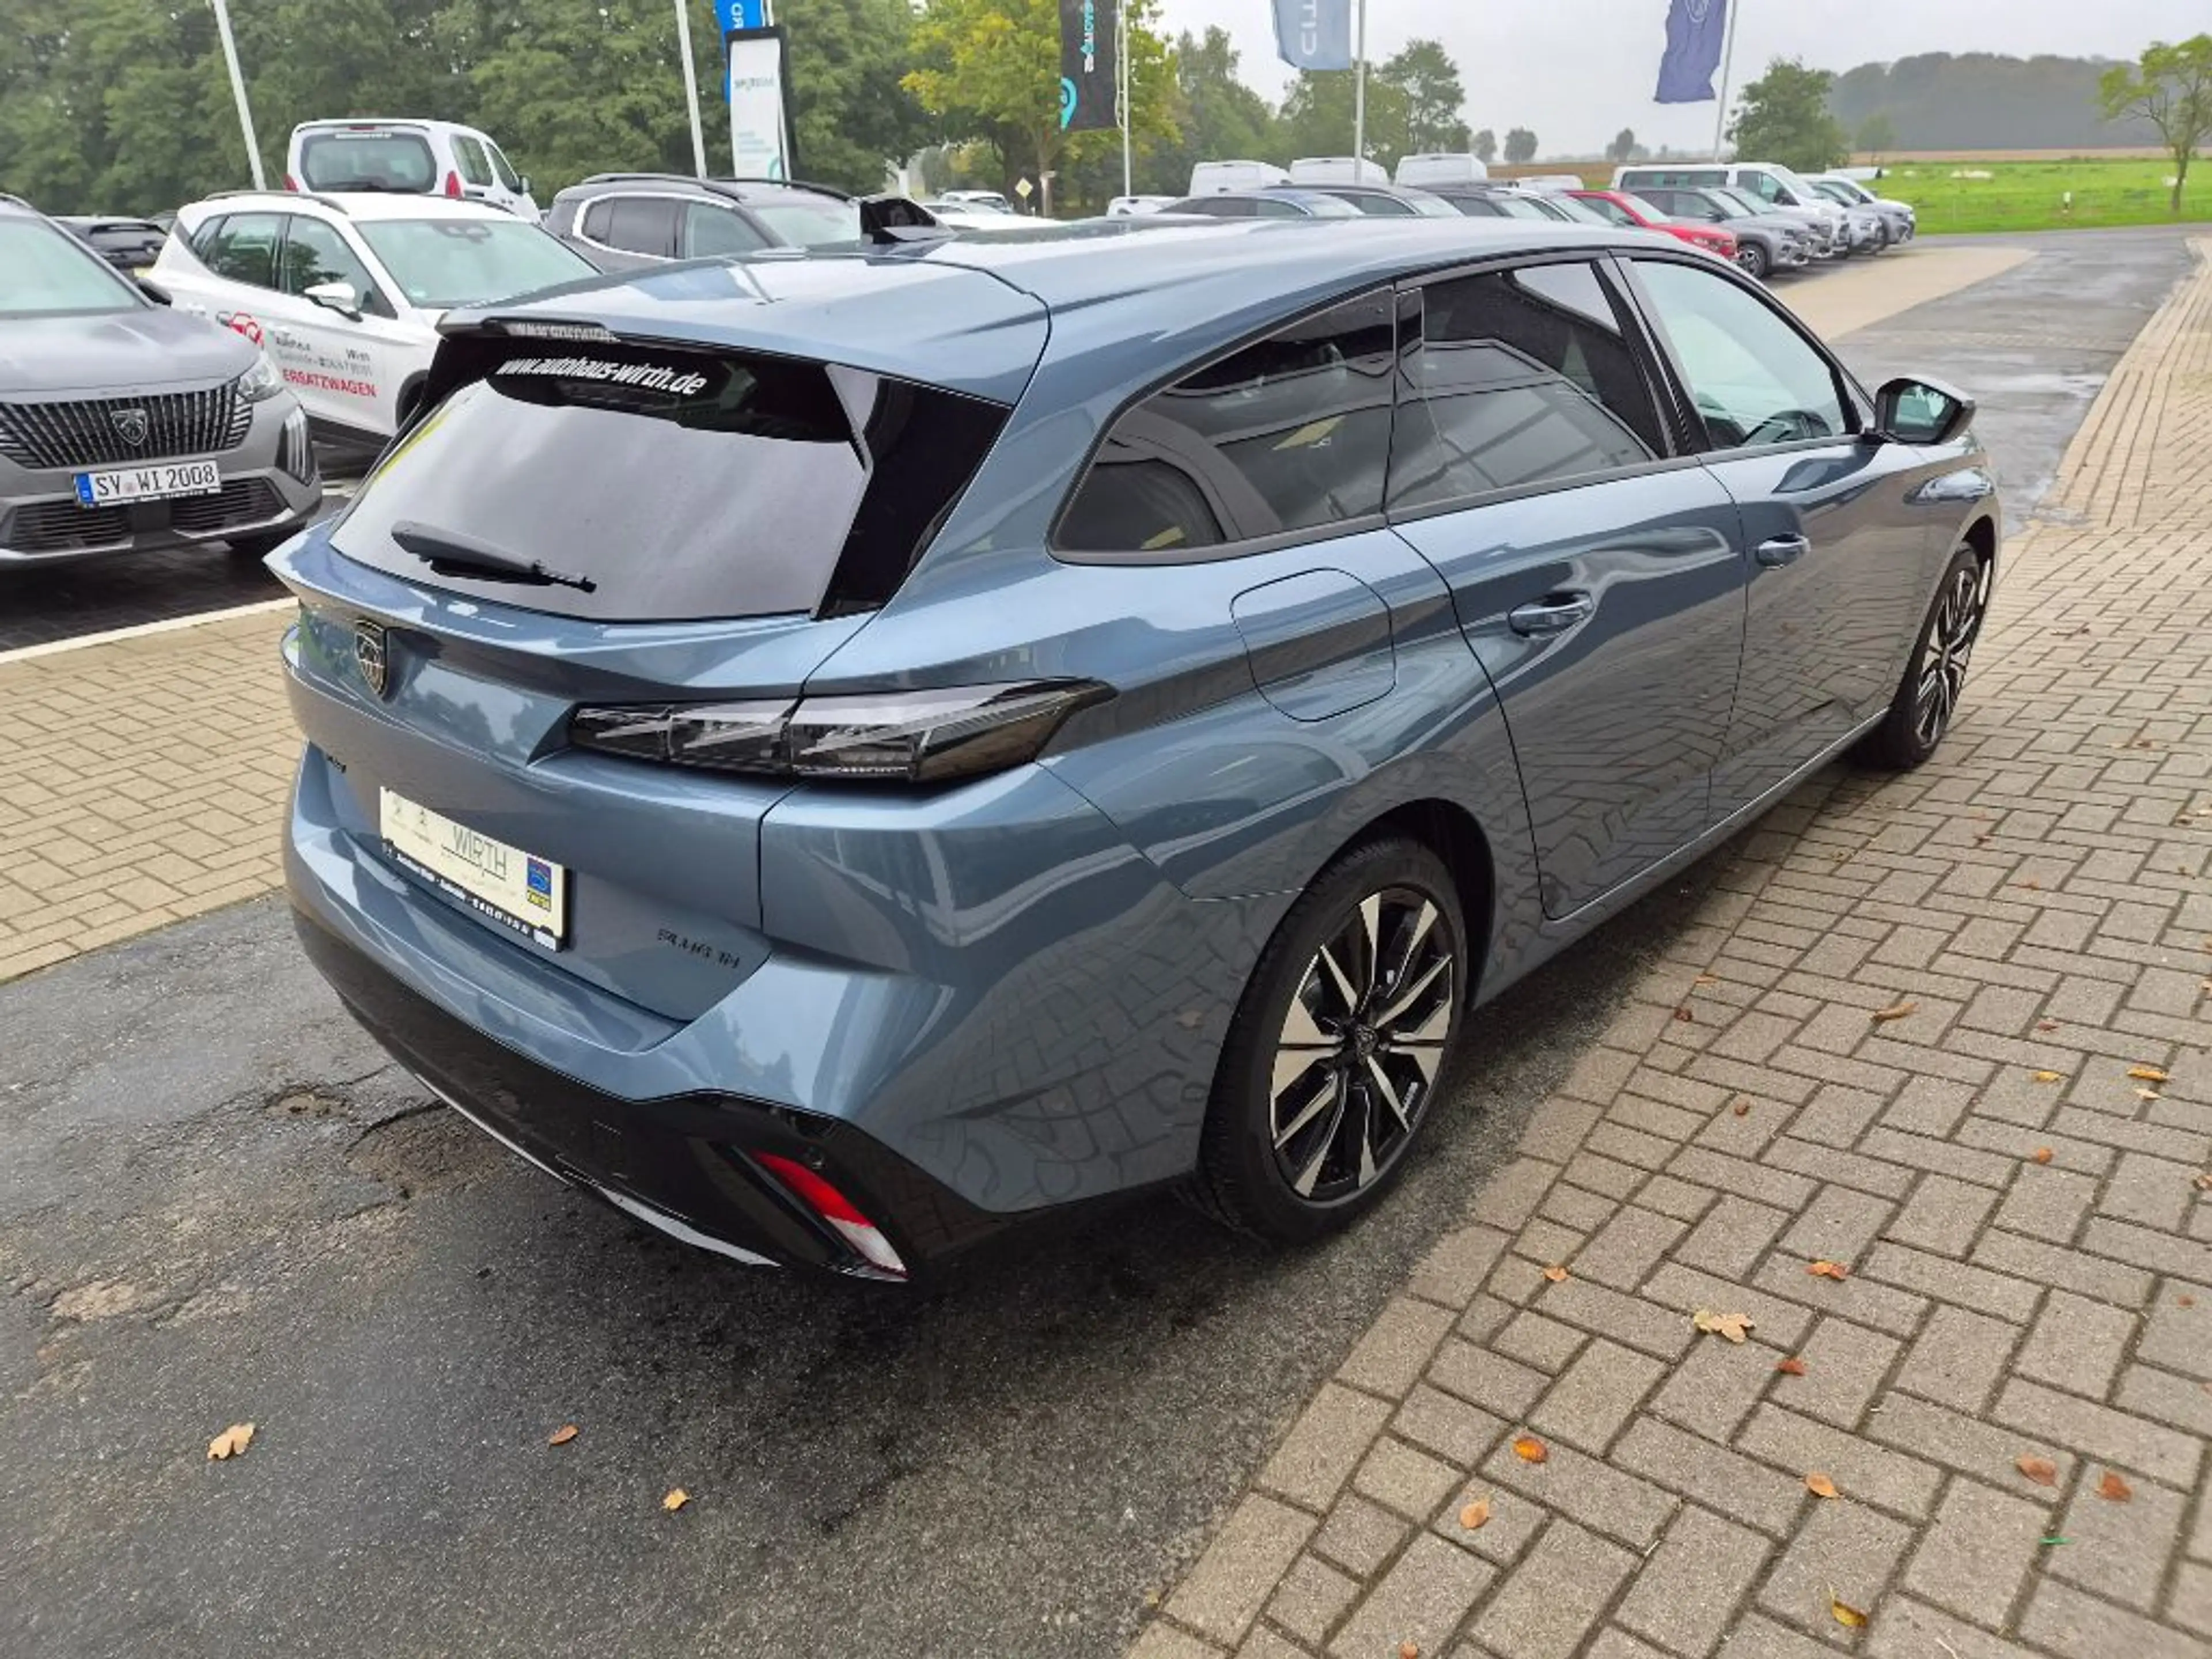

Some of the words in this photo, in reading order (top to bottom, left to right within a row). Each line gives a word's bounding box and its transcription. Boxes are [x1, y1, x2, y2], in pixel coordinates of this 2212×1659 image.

[282, 368, 377, 397] ERSATZWAGEN
[496, 356, 707, 395] www.autohaus-wirth.de
[96, 475, 120, 497] SY
[135, 470, 162, 493] WI
[166, 464, 215, 490] 2008
[453, 824, 507, 877] WIRTH
